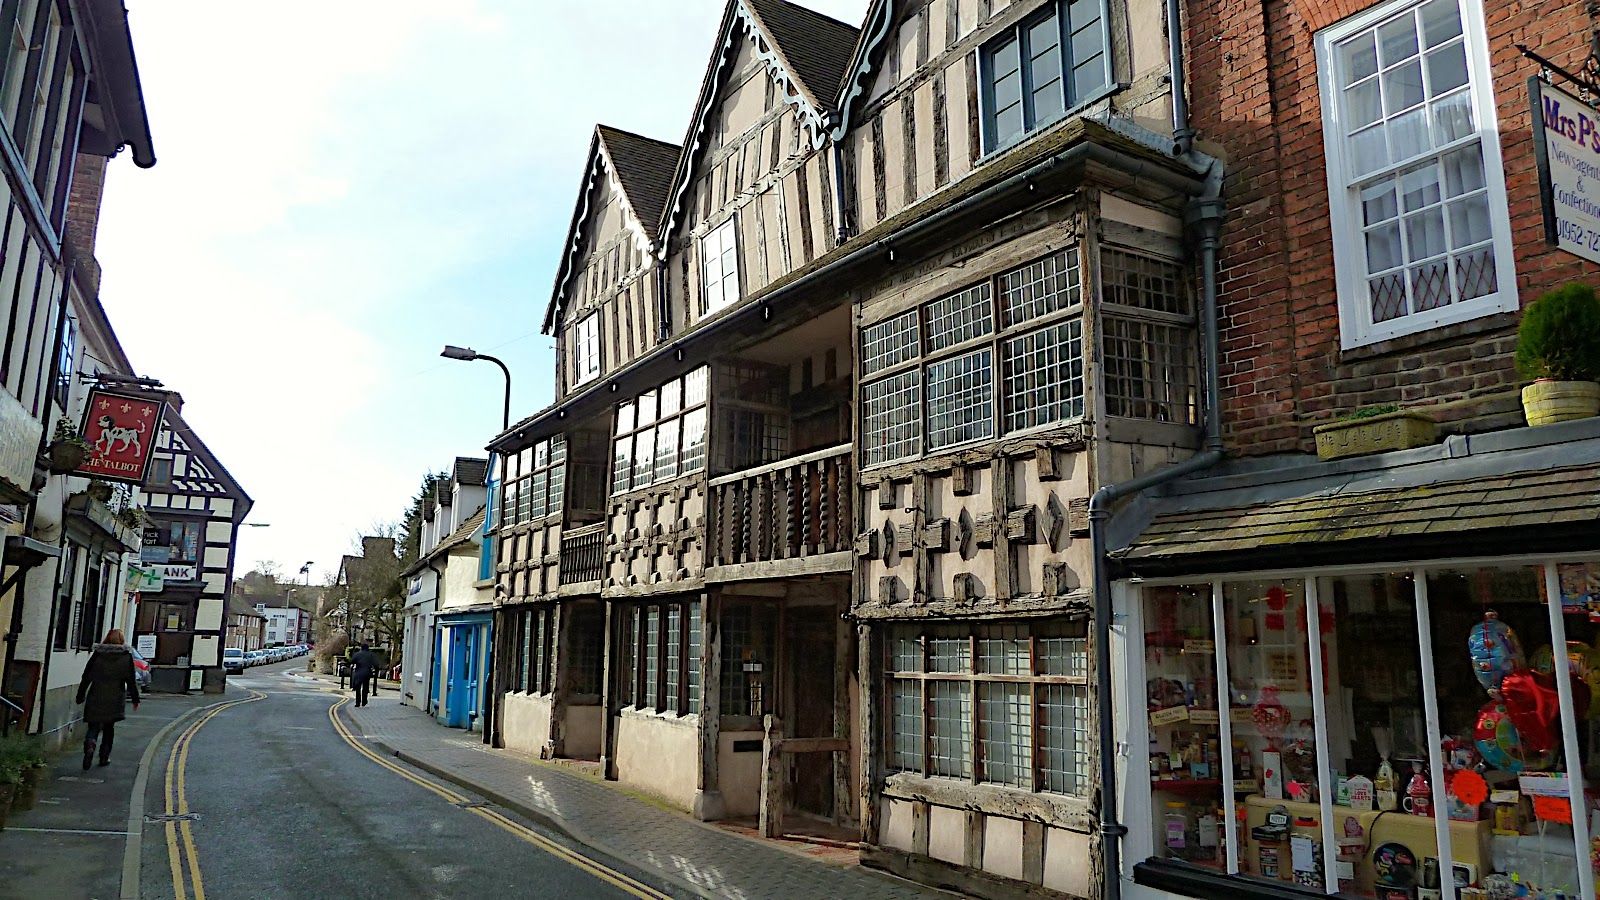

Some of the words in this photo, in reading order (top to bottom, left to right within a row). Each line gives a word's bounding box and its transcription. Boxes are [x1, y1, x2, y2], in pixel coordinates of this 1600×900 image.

[1543, 95, 1577, 141] Mrs
[1577, 112, 1600, 155] P's
[1576, 175, 1586, 193] &
[1552, 183, 1600, 219] Confection
[1556, 217, 1600, 252] 01952-72
[104, 459, 141, 472] TALBOT
[163, 567, 189, 578] ANK
